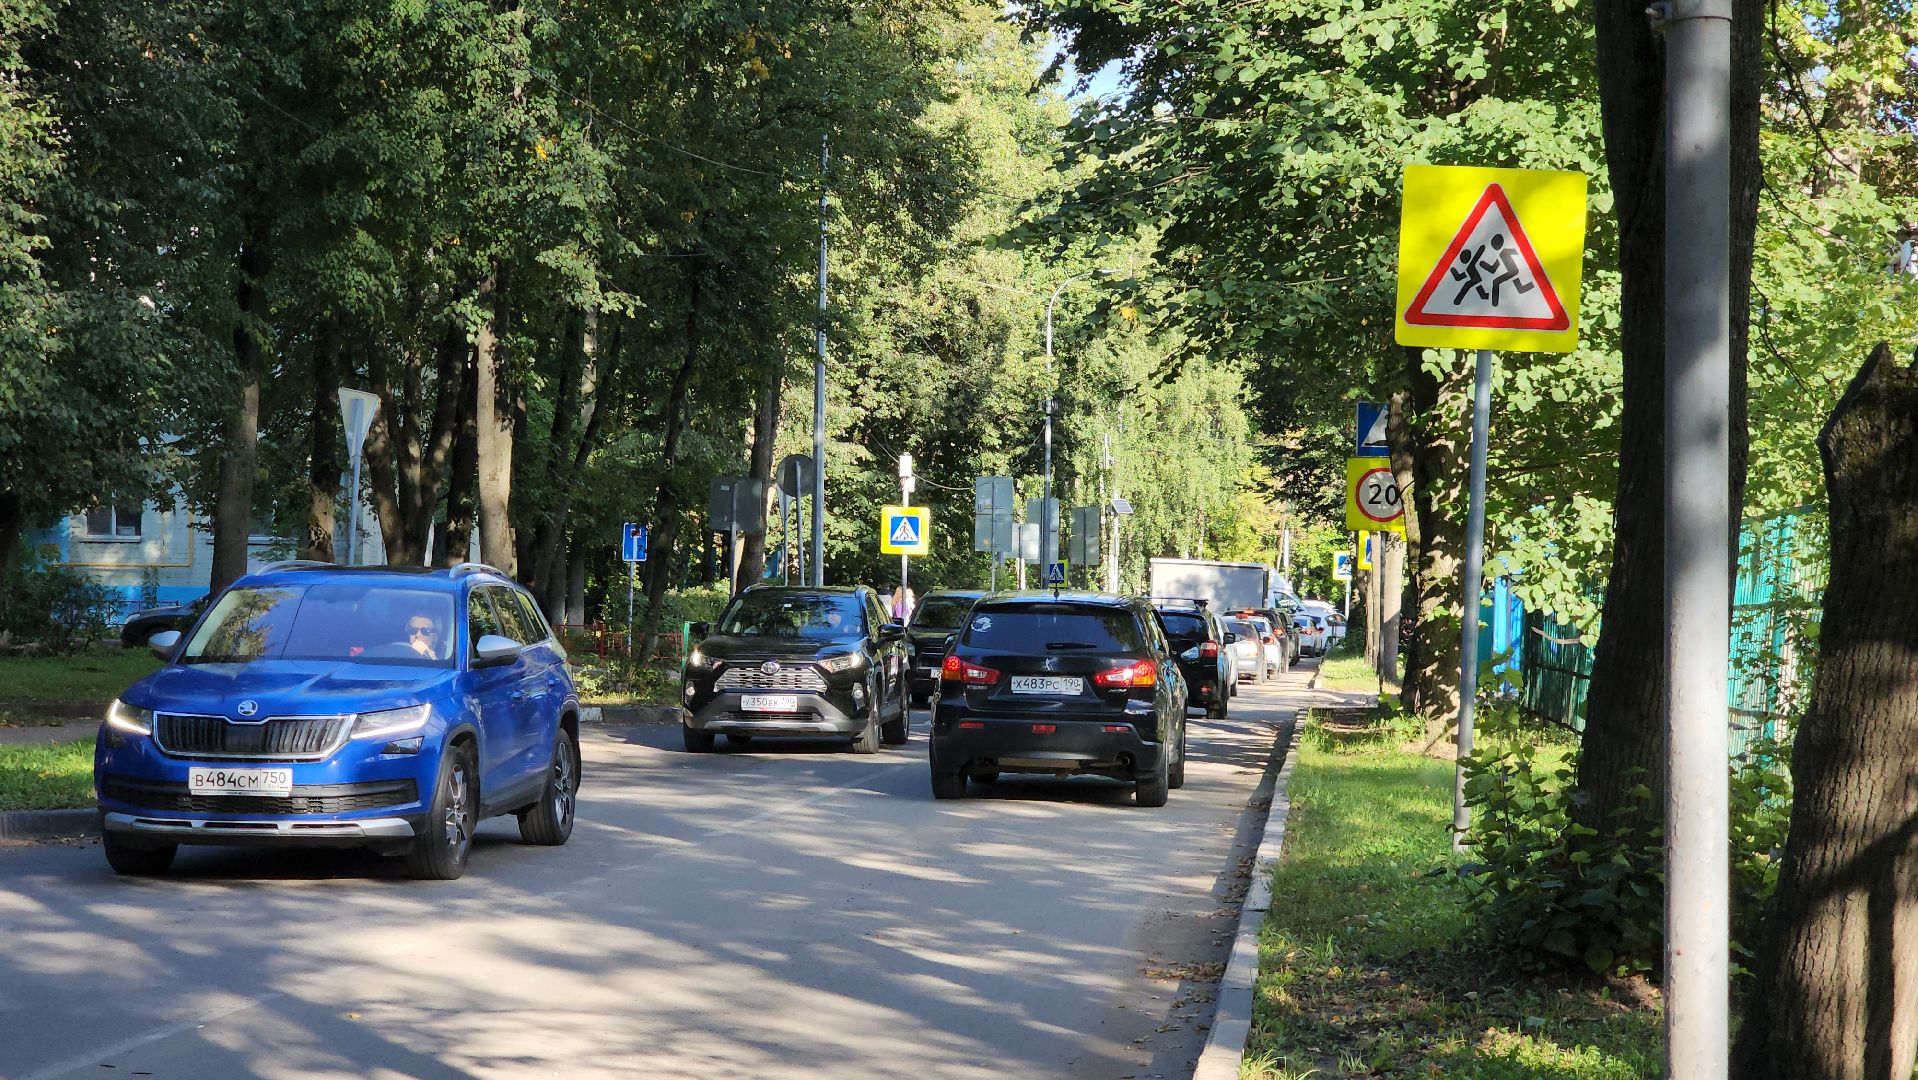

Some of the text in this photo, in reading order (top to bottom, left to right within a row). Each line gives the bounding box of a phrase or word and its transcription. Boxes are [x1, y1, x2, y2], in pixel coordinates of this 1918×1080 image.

[1368, 484, 1400, 506] 20
[195, 771, 286, 788] В484СМ 750
